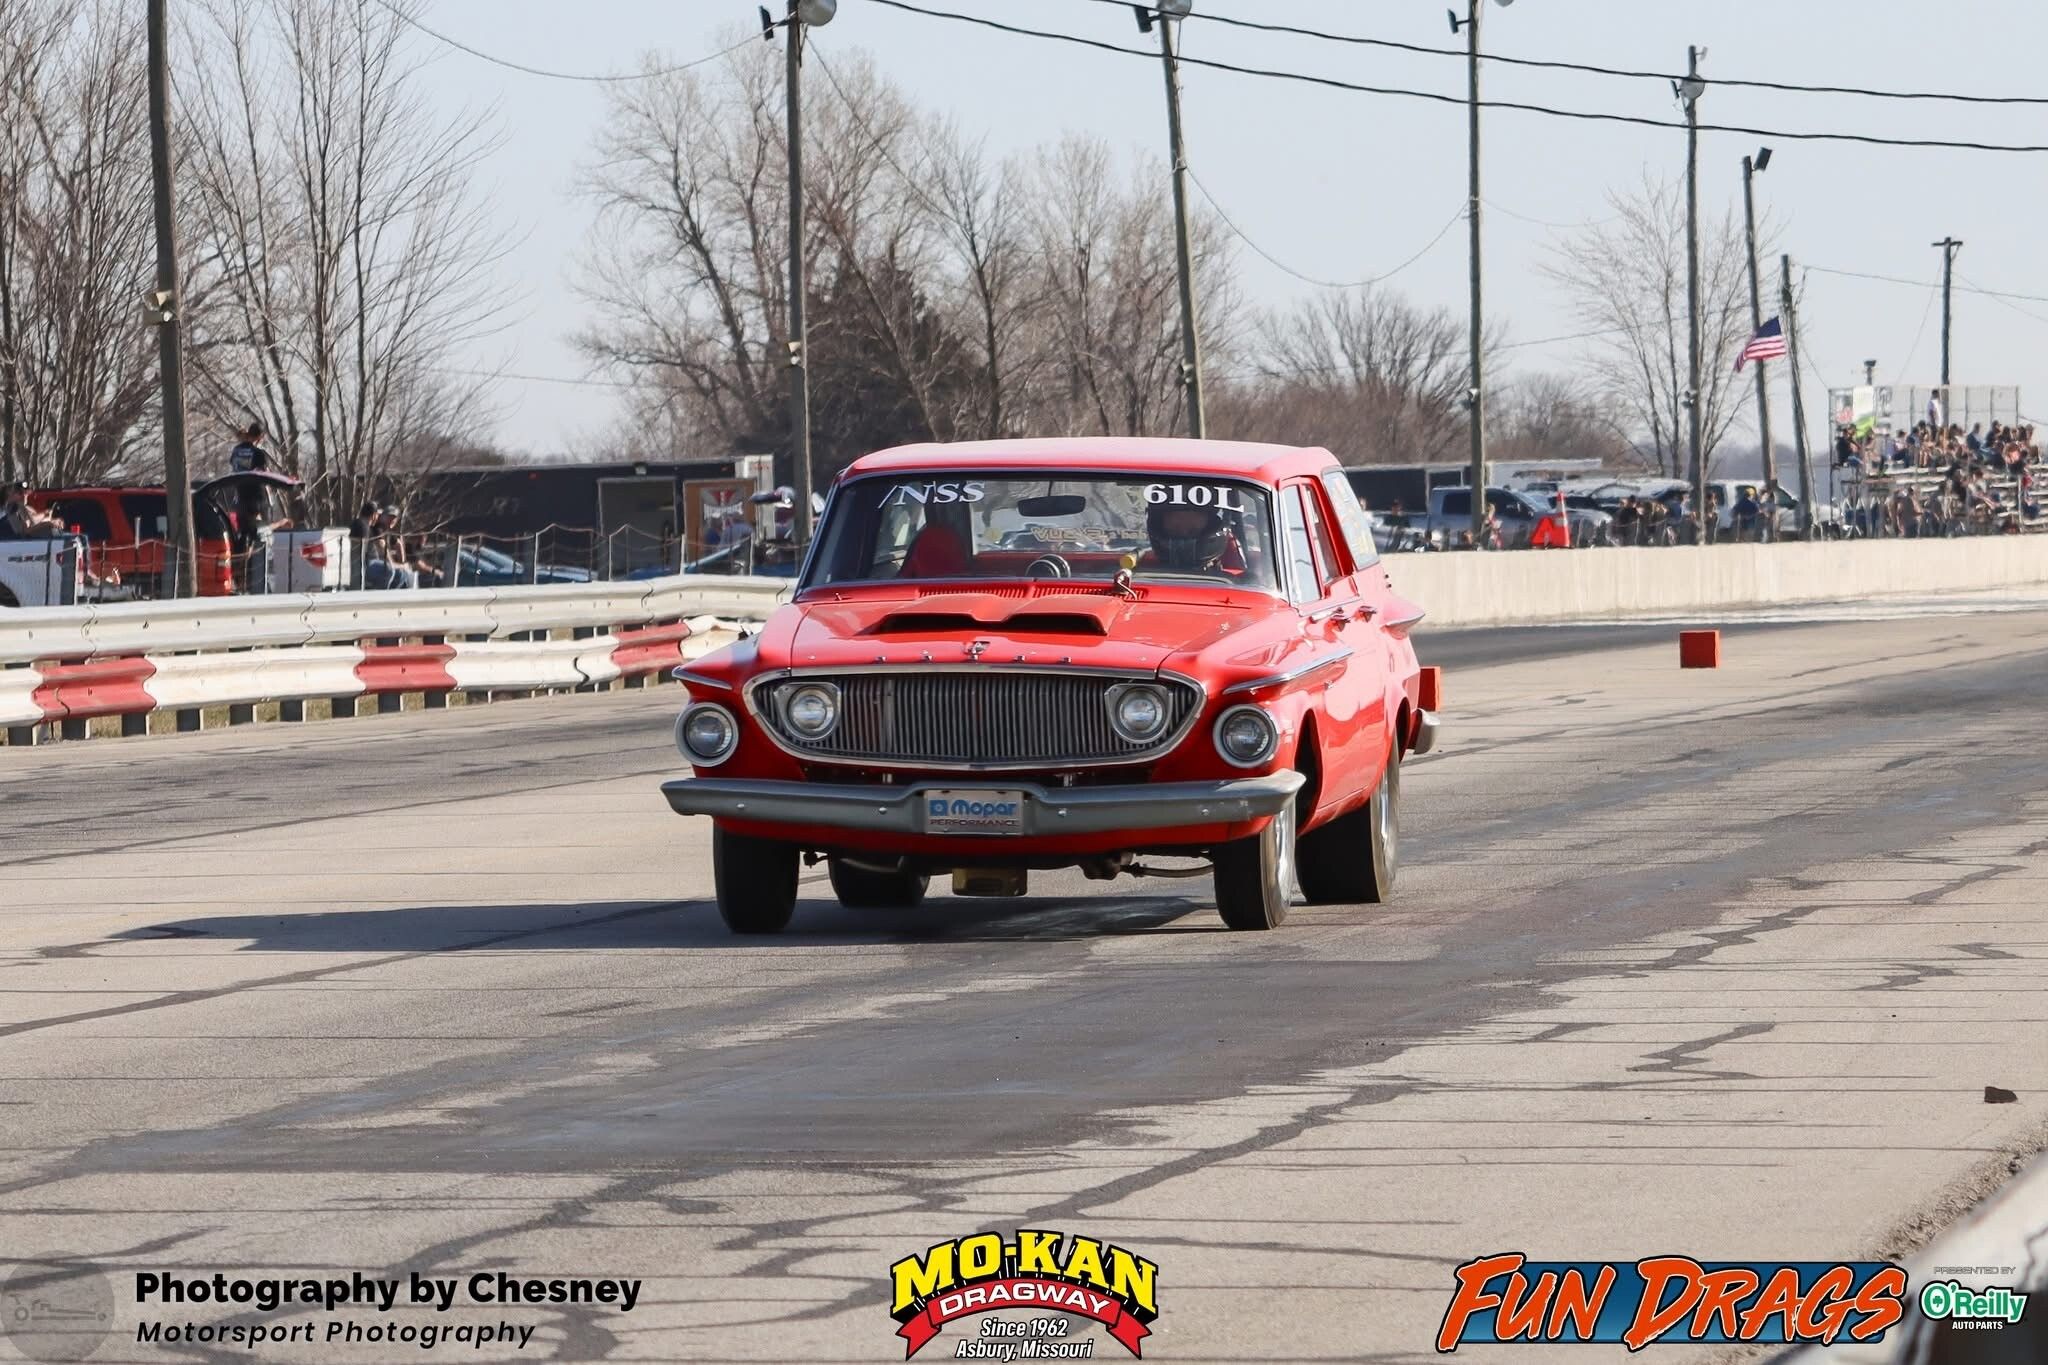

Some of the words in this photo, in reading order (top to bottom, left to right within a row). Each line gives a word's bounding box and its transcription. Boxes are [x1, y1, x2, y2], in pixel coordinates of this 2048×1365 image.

[1143, 483, 1244, 512] 610L
[951, 799, 1018, 817] Mopar
[929, 818, 1020, 827] PERFORMANCE
